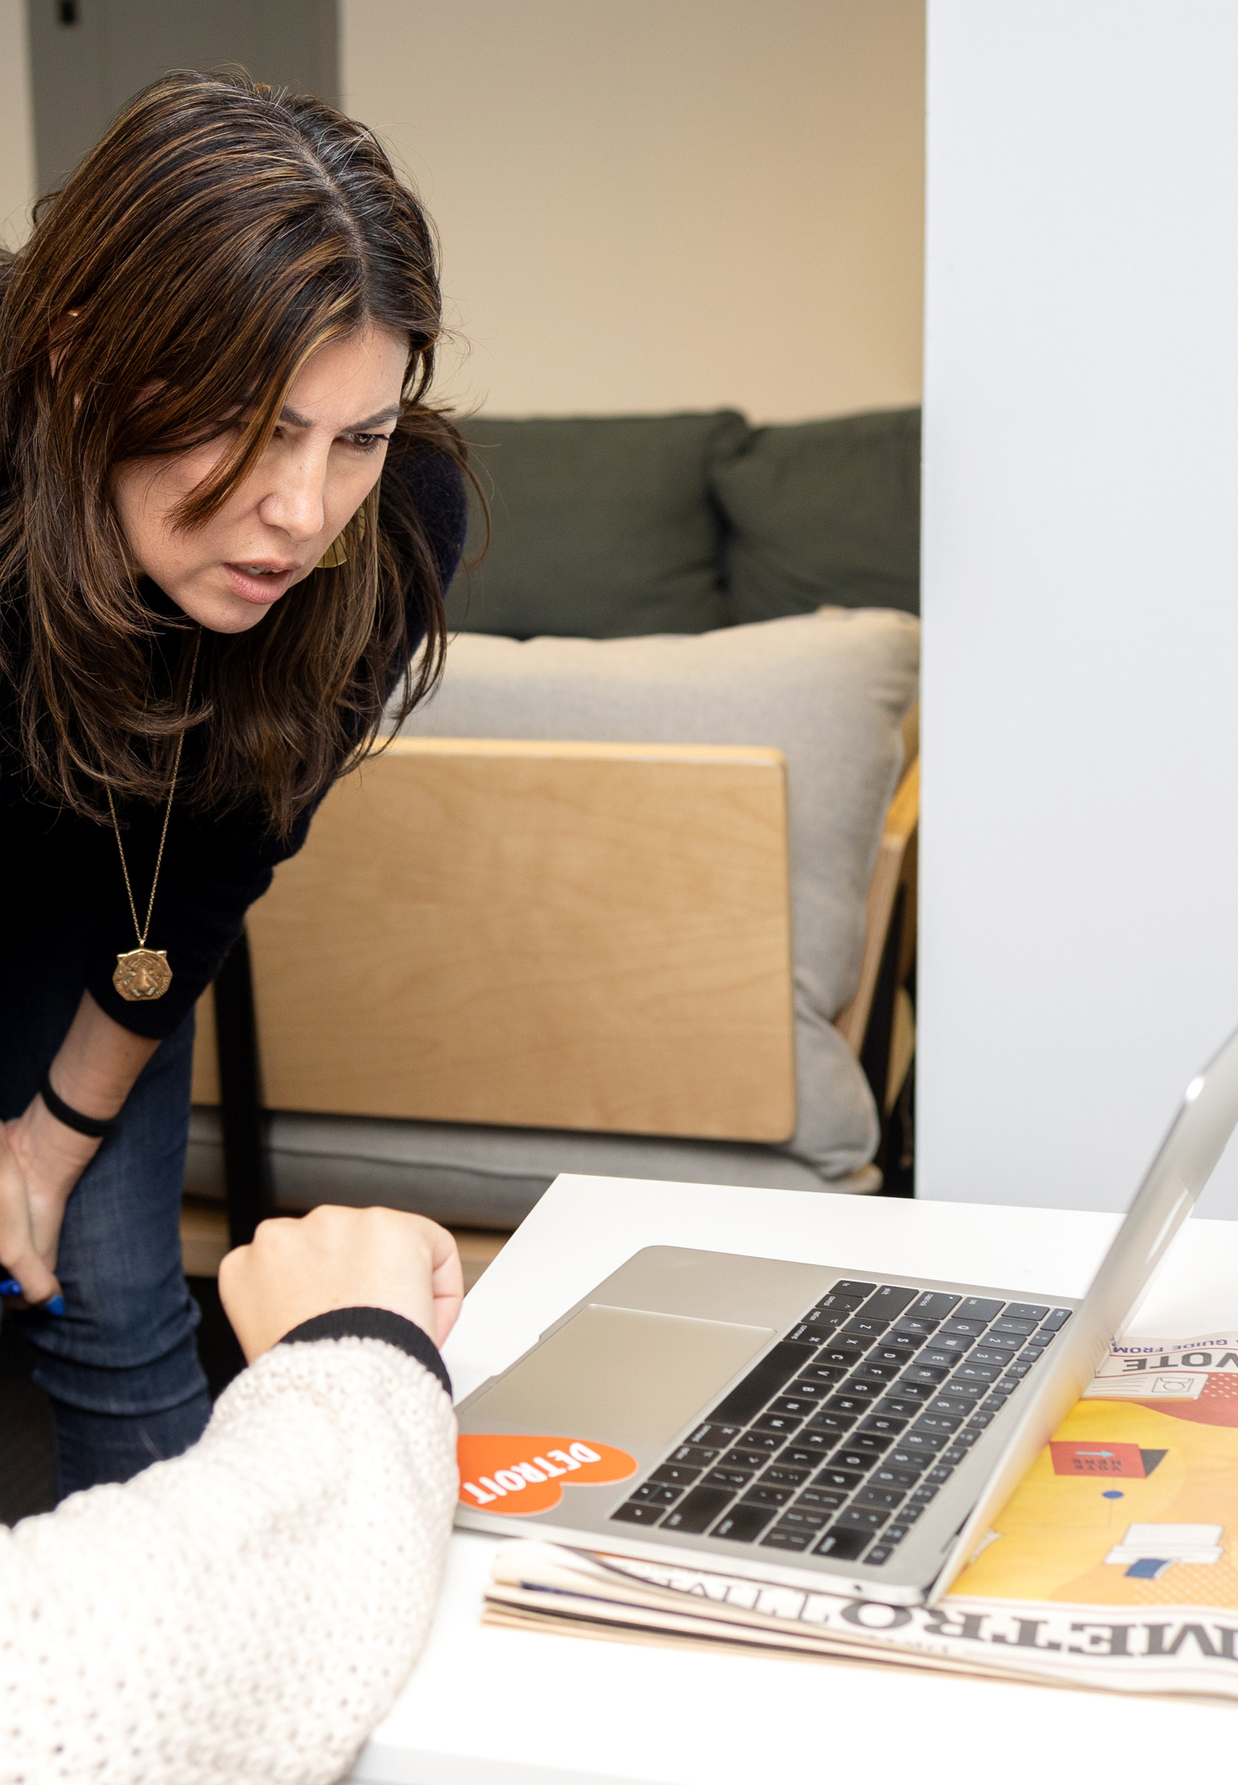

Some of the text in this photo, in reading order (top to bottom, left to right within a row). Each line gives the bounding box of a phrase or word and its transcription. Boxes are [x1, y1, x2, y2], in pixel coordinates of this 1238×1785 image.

[1171, 1339, 1228, 1351] GUIDE
[1112, 1346, 1164, 1354] FROM
[1122, 1352, 1238, 1372] VOTE
[770, 1419, 784, 1427] M
[810, 1435, 824, 1443] K
[909, 1435, 922, 1443] 8
[462, 1442, 602, 1504] DETROIT
[832, 1475, 845, 1483] P
[839, 1600, 1238, 1661] METRO
